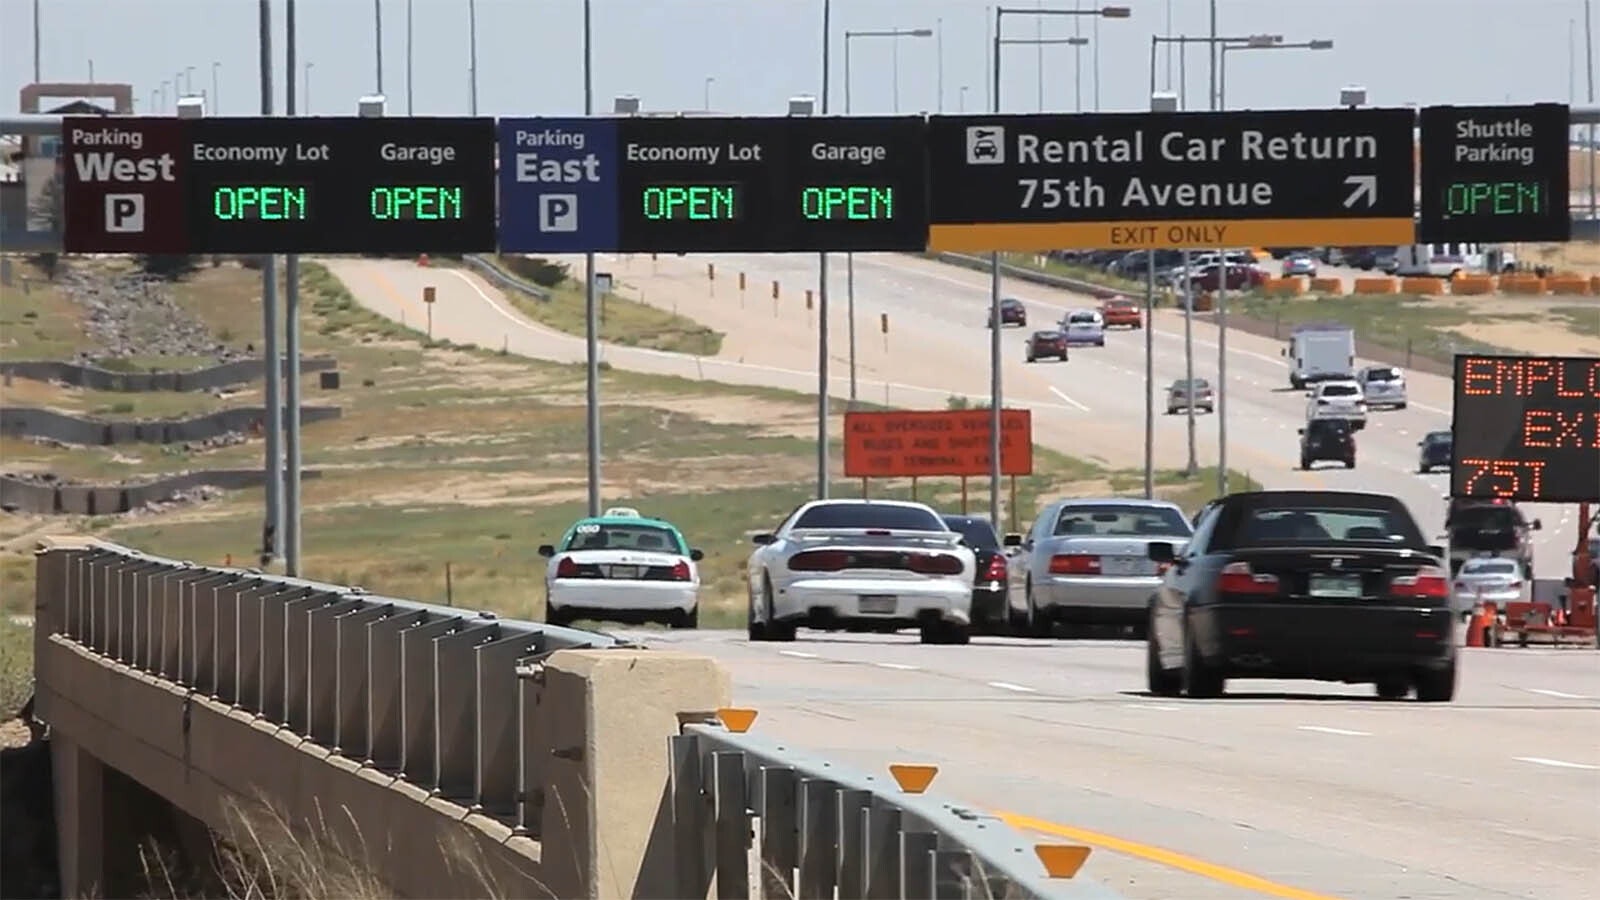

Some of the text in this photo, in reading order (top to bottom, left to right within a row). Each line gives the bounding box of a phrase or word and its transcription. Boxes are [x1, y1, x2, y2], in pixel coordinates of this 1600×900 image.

[73, 129, 142, 149] Parking
[517, 130, 584, 149] Parking
[1457, 119, 1532, 138] Shuttle
[194, 144, 328, 165] Economy Lot
[381, 143, 455, 165] Garage
[628, 144, 760, 164] Economy Lot
[812, 143, 885, 164] Garage
[1018, 131, 1376, 163] Rental Car Return
[1456, 143, 1533, 165] Parking
[74, 152, 175, 181] West
[517, 153, 600, 182] East
[215, 187, 304, 219] OPEN
[372, 187, 460, 219] OPEN
[644, 187, 732, 219] OPEN
[803, 187, 891, 219] OPEN
[1019, 177, 1272, 208] 75th Avenue
[1450, 183, 1538, 214] OPEN
[1111, 226, 1227, 244] EXIT ONLY
[1462, 460, 1546, 497] 75T
